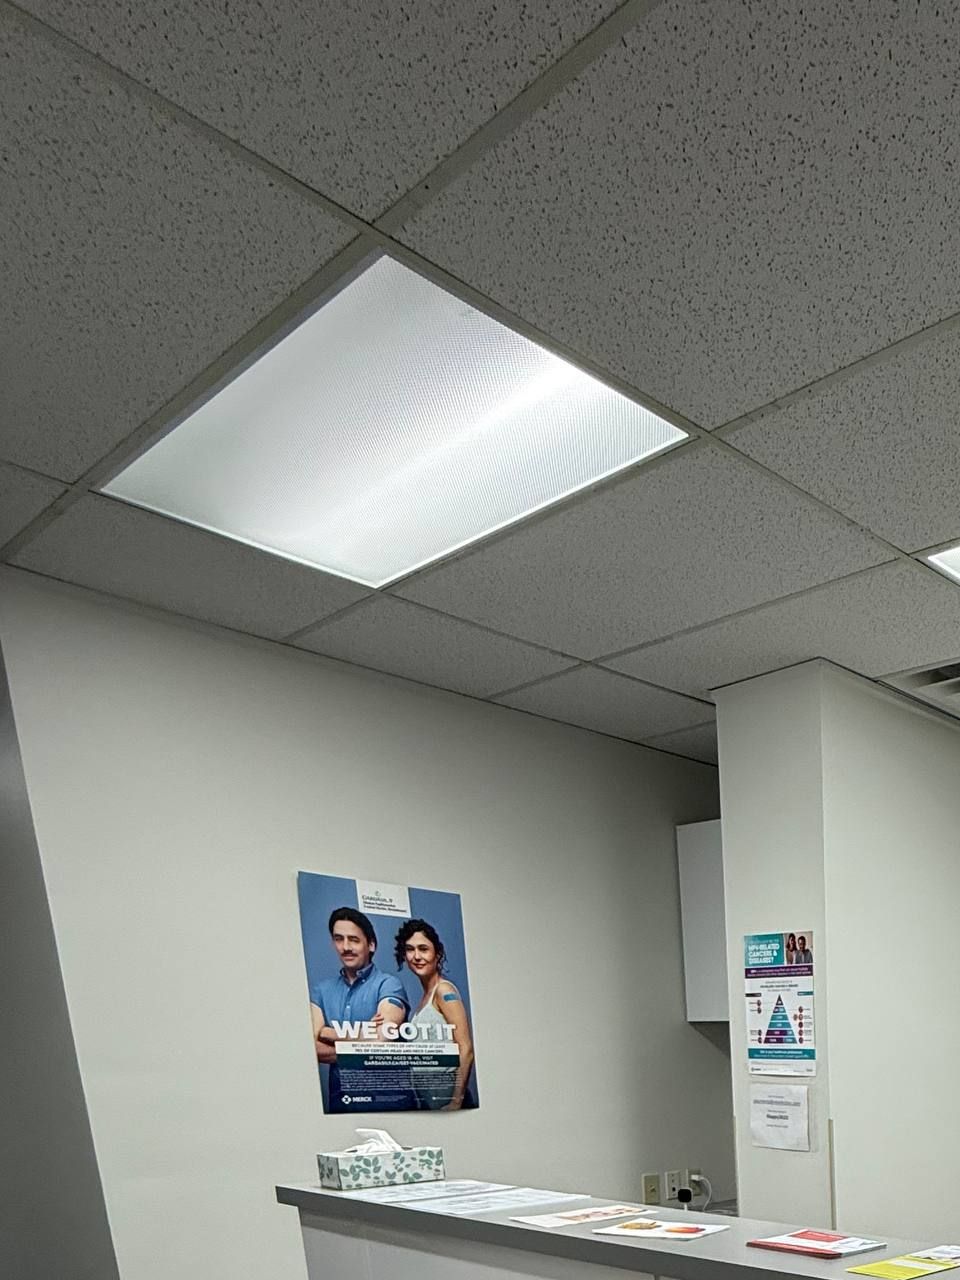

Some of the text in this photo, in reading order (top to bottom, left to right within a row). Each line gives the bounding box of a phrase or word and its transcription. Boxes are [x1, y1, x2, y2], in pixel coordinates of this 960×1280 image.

[331, 1020, 457, 1041] WE GOT IT
